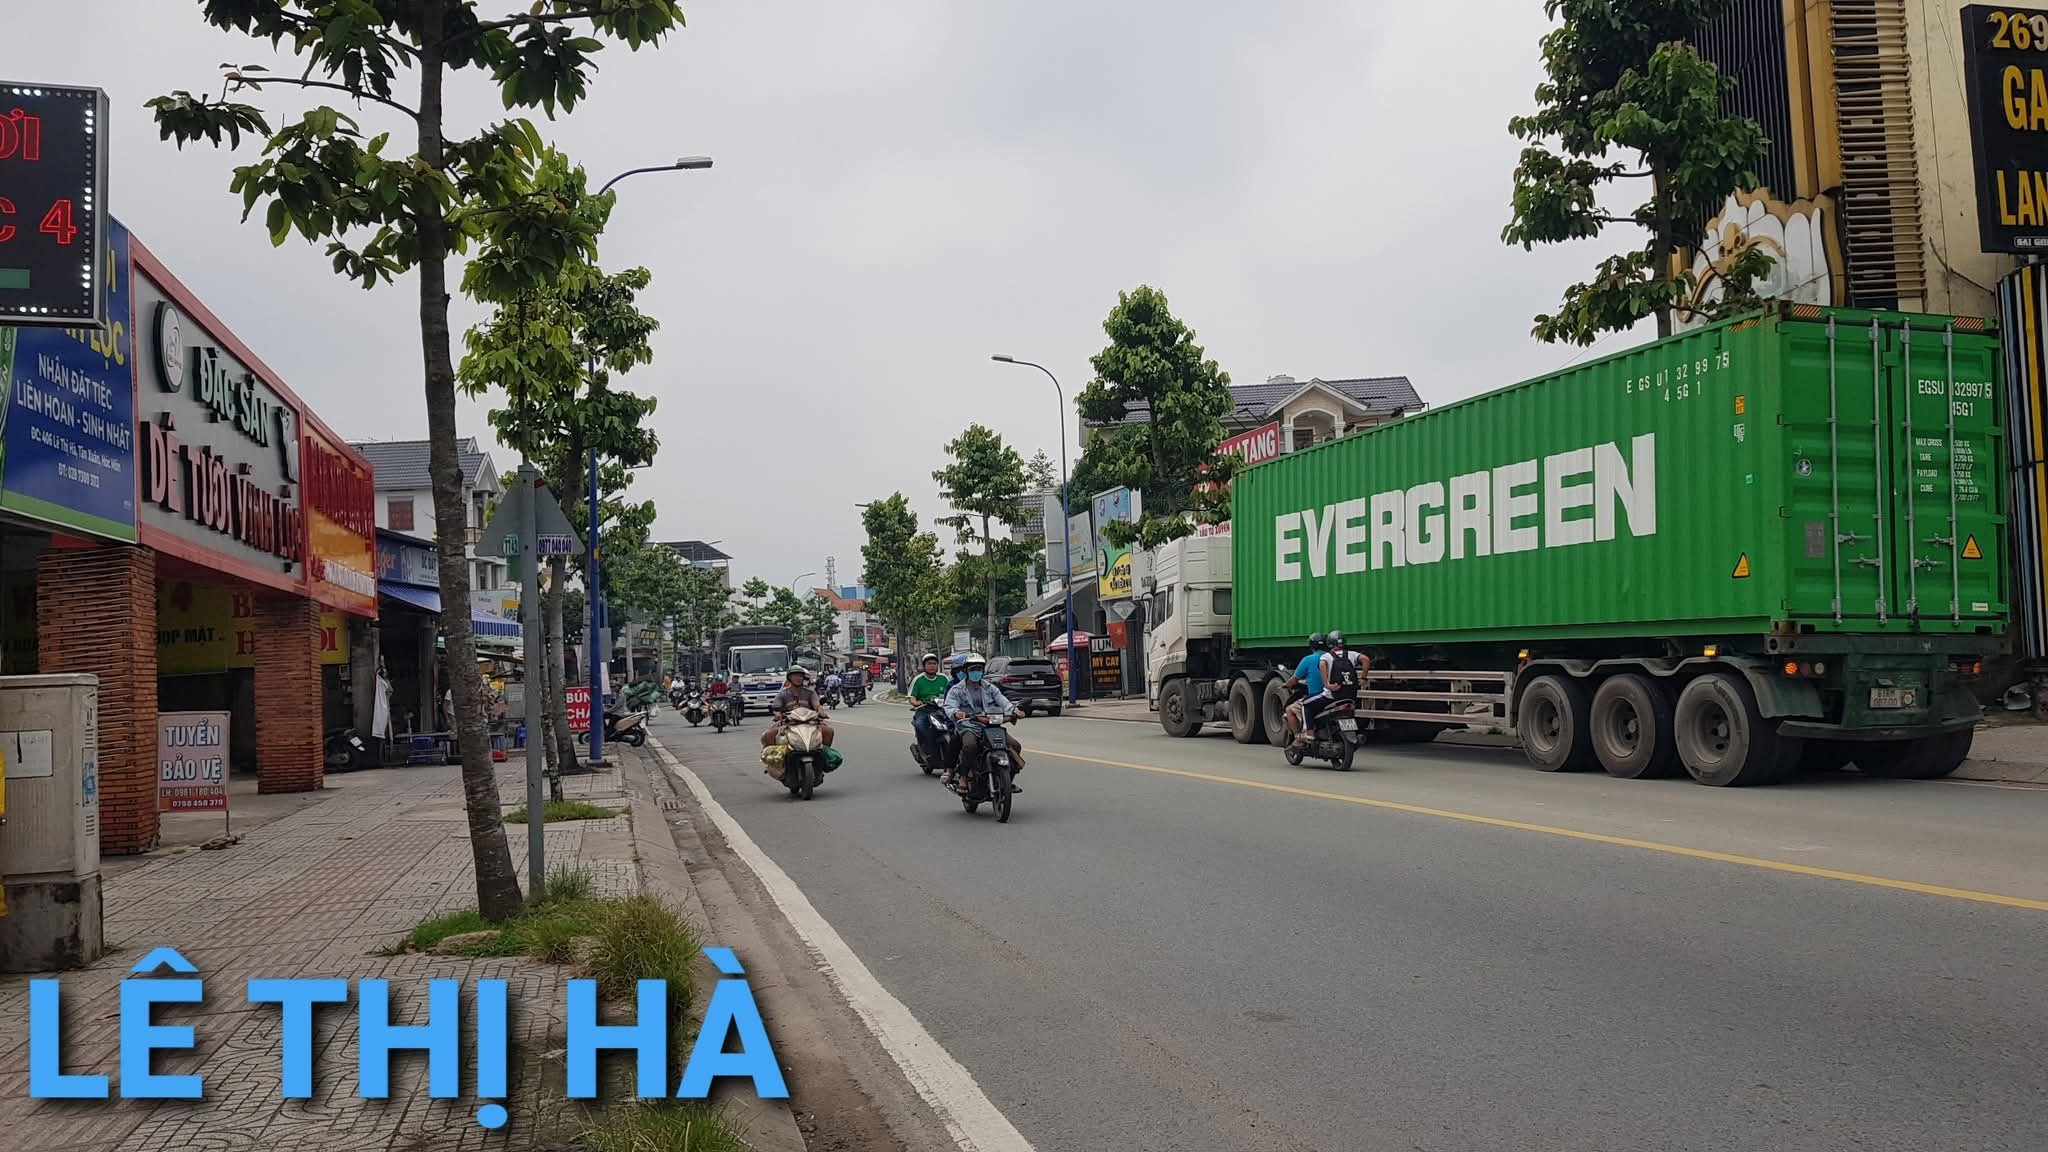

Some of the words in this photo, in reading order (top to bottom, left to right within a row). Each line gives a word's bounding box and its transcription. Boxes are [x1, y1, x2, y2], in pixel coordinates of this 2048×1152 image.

[40, 199, 77, 244] 4
[38, 352, 69, 391] NHẬN
[71, 369, 91, 402] ĐẶT
[92, 381, 112, 412] TIỆC
[199, 346, 235, 423] ĐẶC
[240, 373, 269, 447] SẢN
[1918, 379, 1944, 395] EGSU
[16, 378, 42, 414] LIÊN
[44, 394, 75, 428] HOAN
[82, 410, 105, 441] SINH
[106, 420, 130, 455] NHẬT
[150, 412, 182, 514] DÊ
[187, 443, 233, 536] TƯƠI
[1275, 433, 1656, 582] EVERGREEN
[165, 717, 220, 748] TUYỂN
[162, 751, 197, 781] BẢO
[200, 753, 222, 784] VỆ
